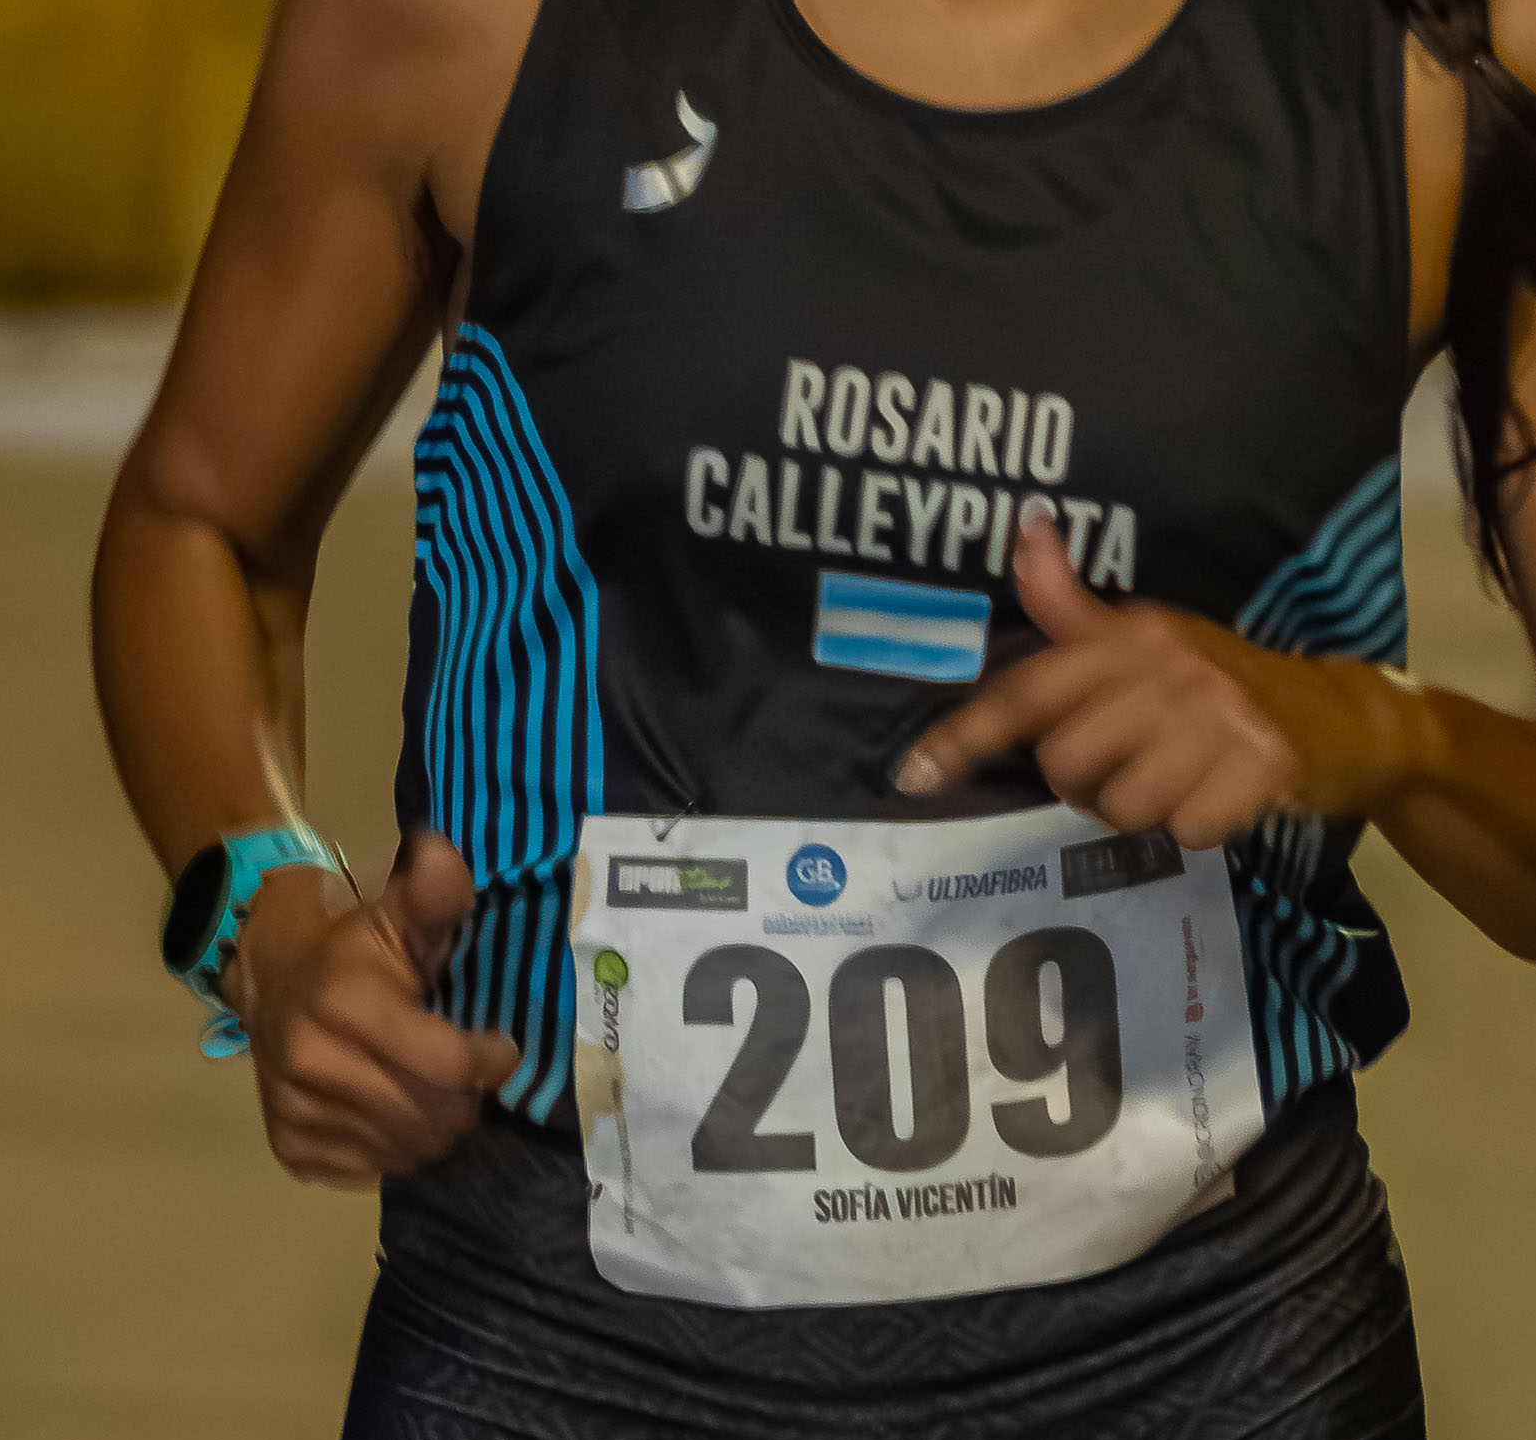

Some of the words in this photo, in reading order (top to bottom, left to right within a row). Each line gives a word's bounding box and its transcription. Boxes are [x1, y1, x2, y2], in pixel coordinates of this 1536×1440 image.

[778, 356, 1075, 486] ROSARIO
[927, 864, 1048, 903] ULTRAFIBRA
[682, 925, 1124, 1173] 209
[814, 1182, 892, 1222] SOFÍA
[895, 1171, 1017, 1221] VICENTÍN
